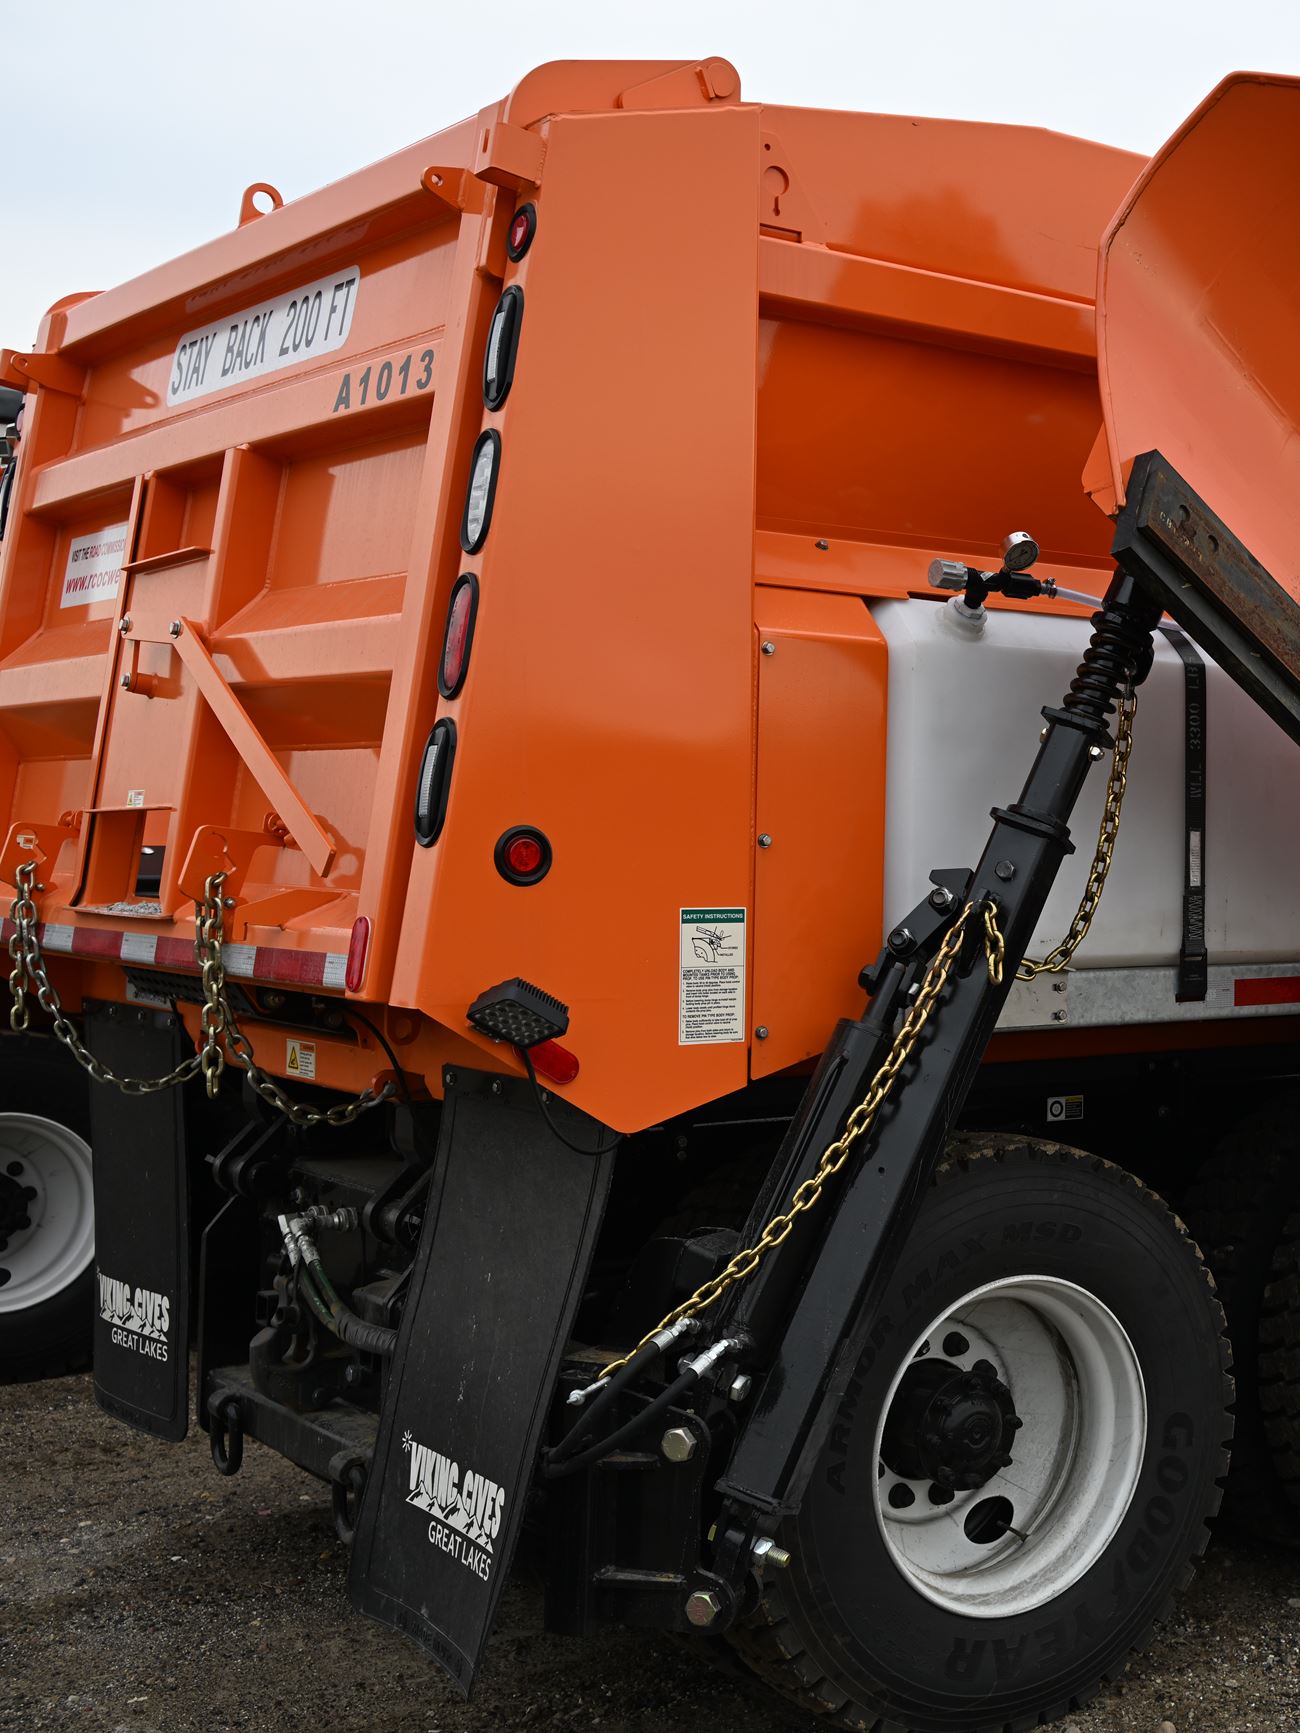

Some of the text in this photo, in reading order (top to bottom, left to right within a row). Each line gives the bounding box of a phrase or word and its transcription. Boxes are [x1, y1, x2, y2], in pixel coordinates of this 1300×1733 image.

[171, 277, 357, 396] STAY BACK 200 FT
[332, 348, 435, 413] A1013
[98, 1272, 131, 1317] VIKING
[111, 1327, 168, 1362] GREAT LAKES
[409, 1441, 460, 1508] VIKING
[428, 1521, 492, 1581] GREAT LAKES
